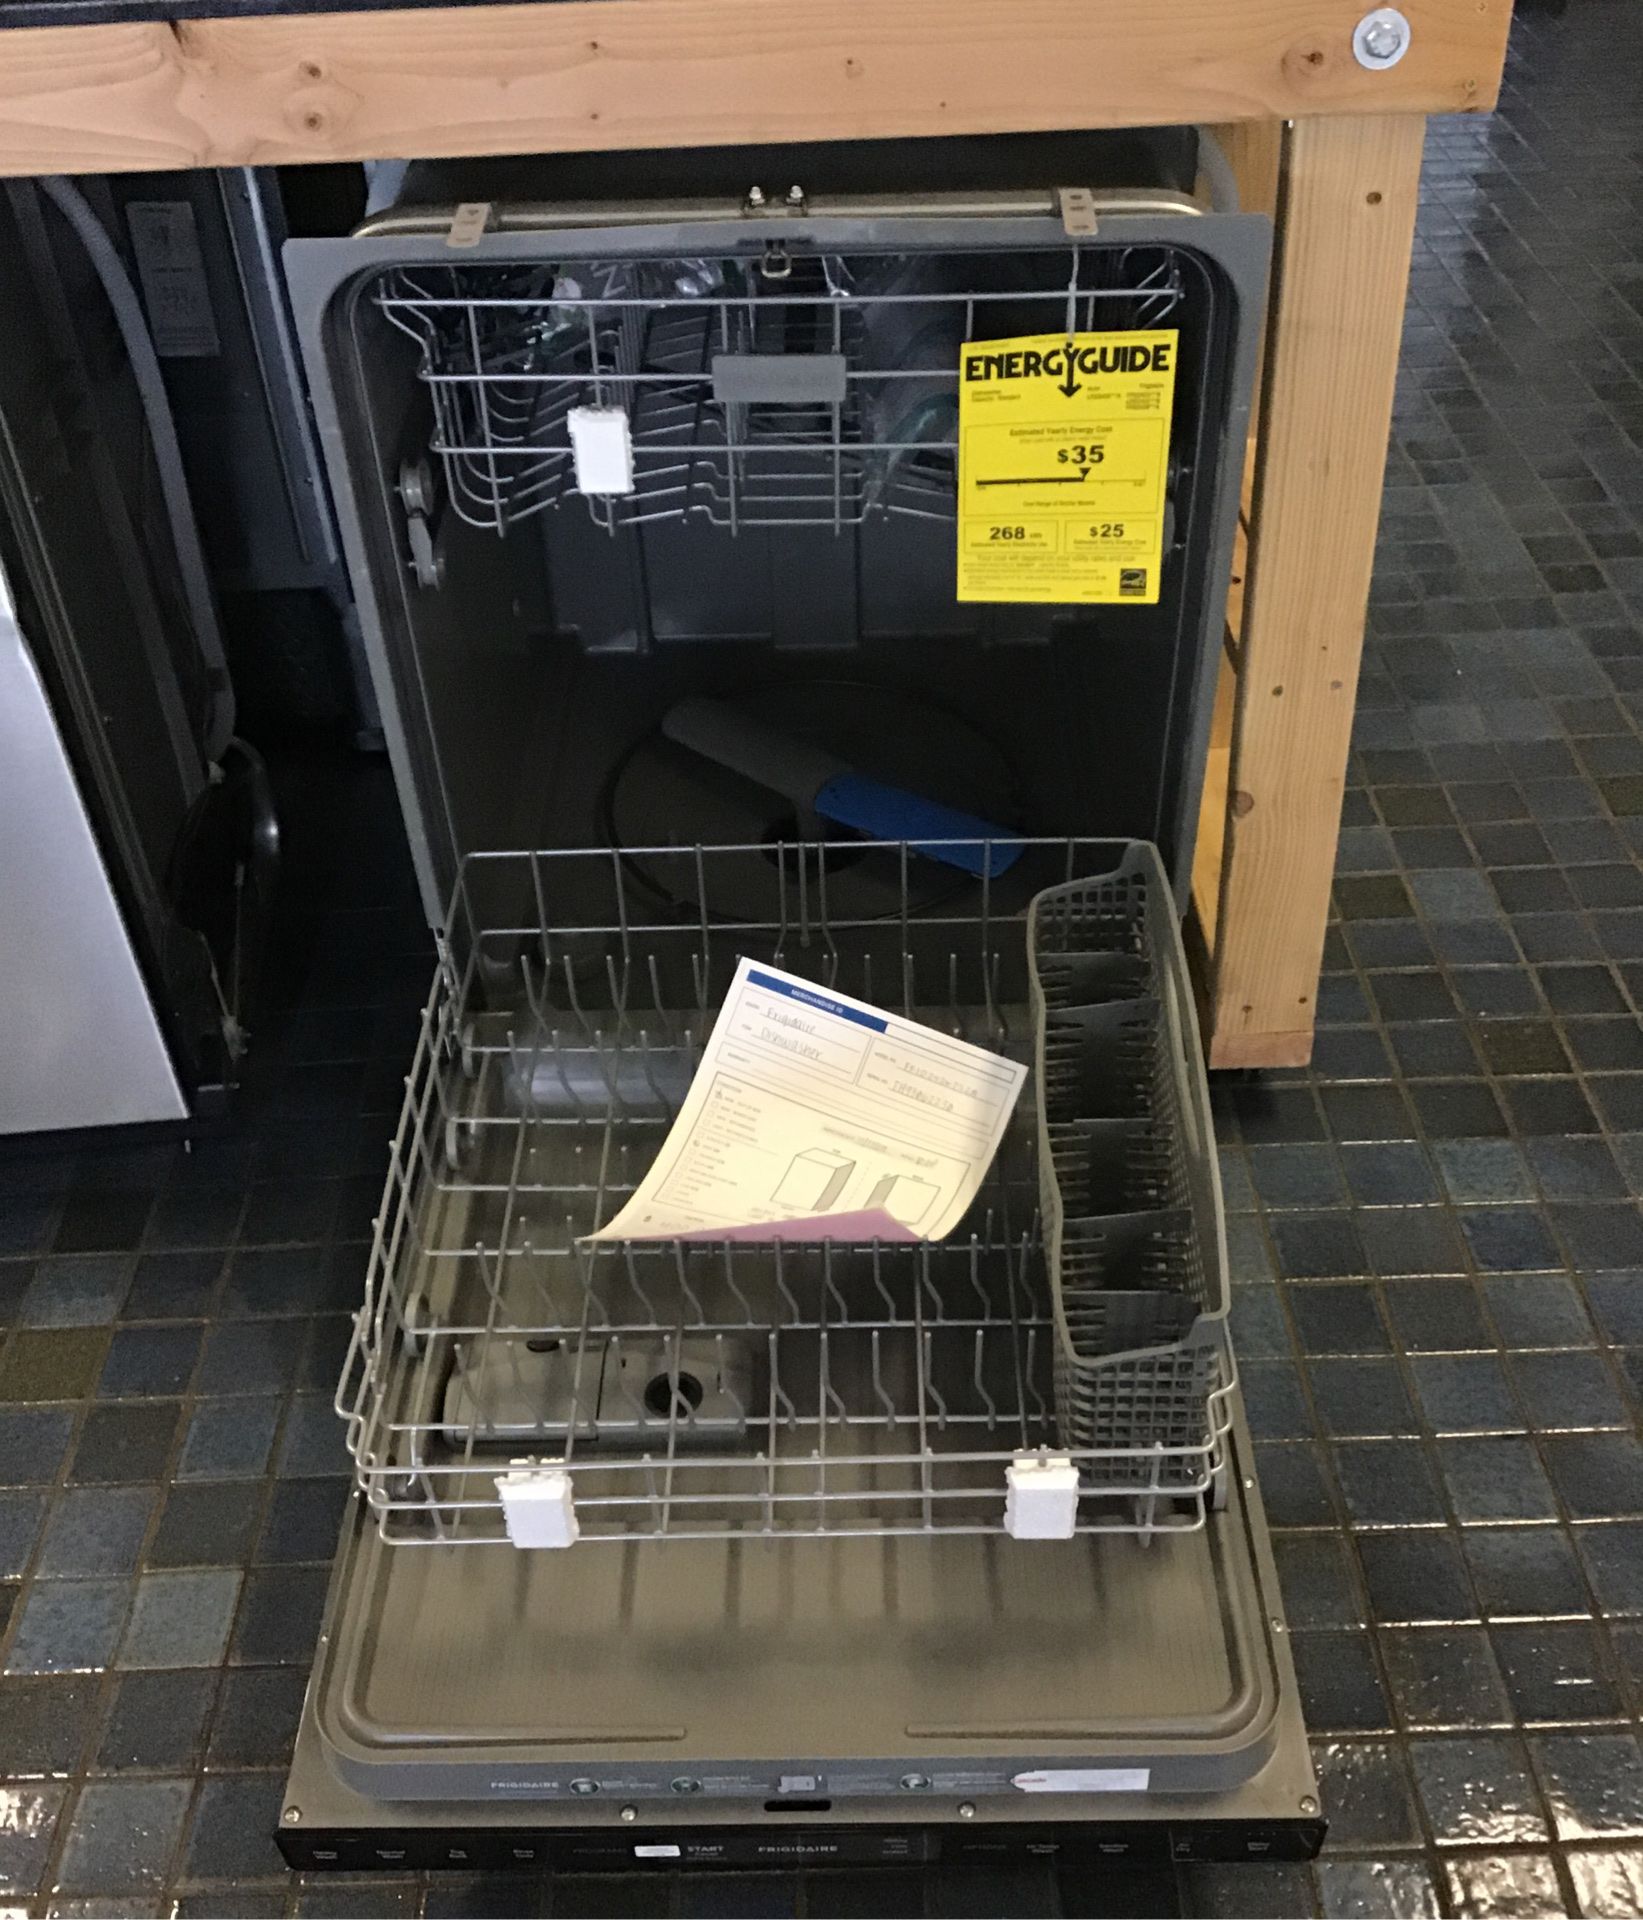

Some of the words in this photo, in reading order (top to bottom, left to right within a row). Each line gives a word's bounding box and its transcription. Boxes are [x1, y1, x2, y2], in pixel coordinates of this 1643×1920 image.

[966, 343, 1171, 384] ENERGYGUIDE
[1009, 428, 1045, 436] Estimated
[1046, 427, 1067, 435] Yearly
[1069, 426, 1094, 435] Energy
[1095, 425, 1113, 433] Cost
[1057, 444, 1105, 464] $35
[989, 526, 1025, 540] 268
[1090, 523, 1124, 538] $25
[791, 989, 835, 1011] MERCHANDISE
[490, 1781, 559, 1789] FRIGIDAIRE
[687, 1845, 724, 1853] START
[758, 1845, 838, 1853] FRIGIDAIRE
